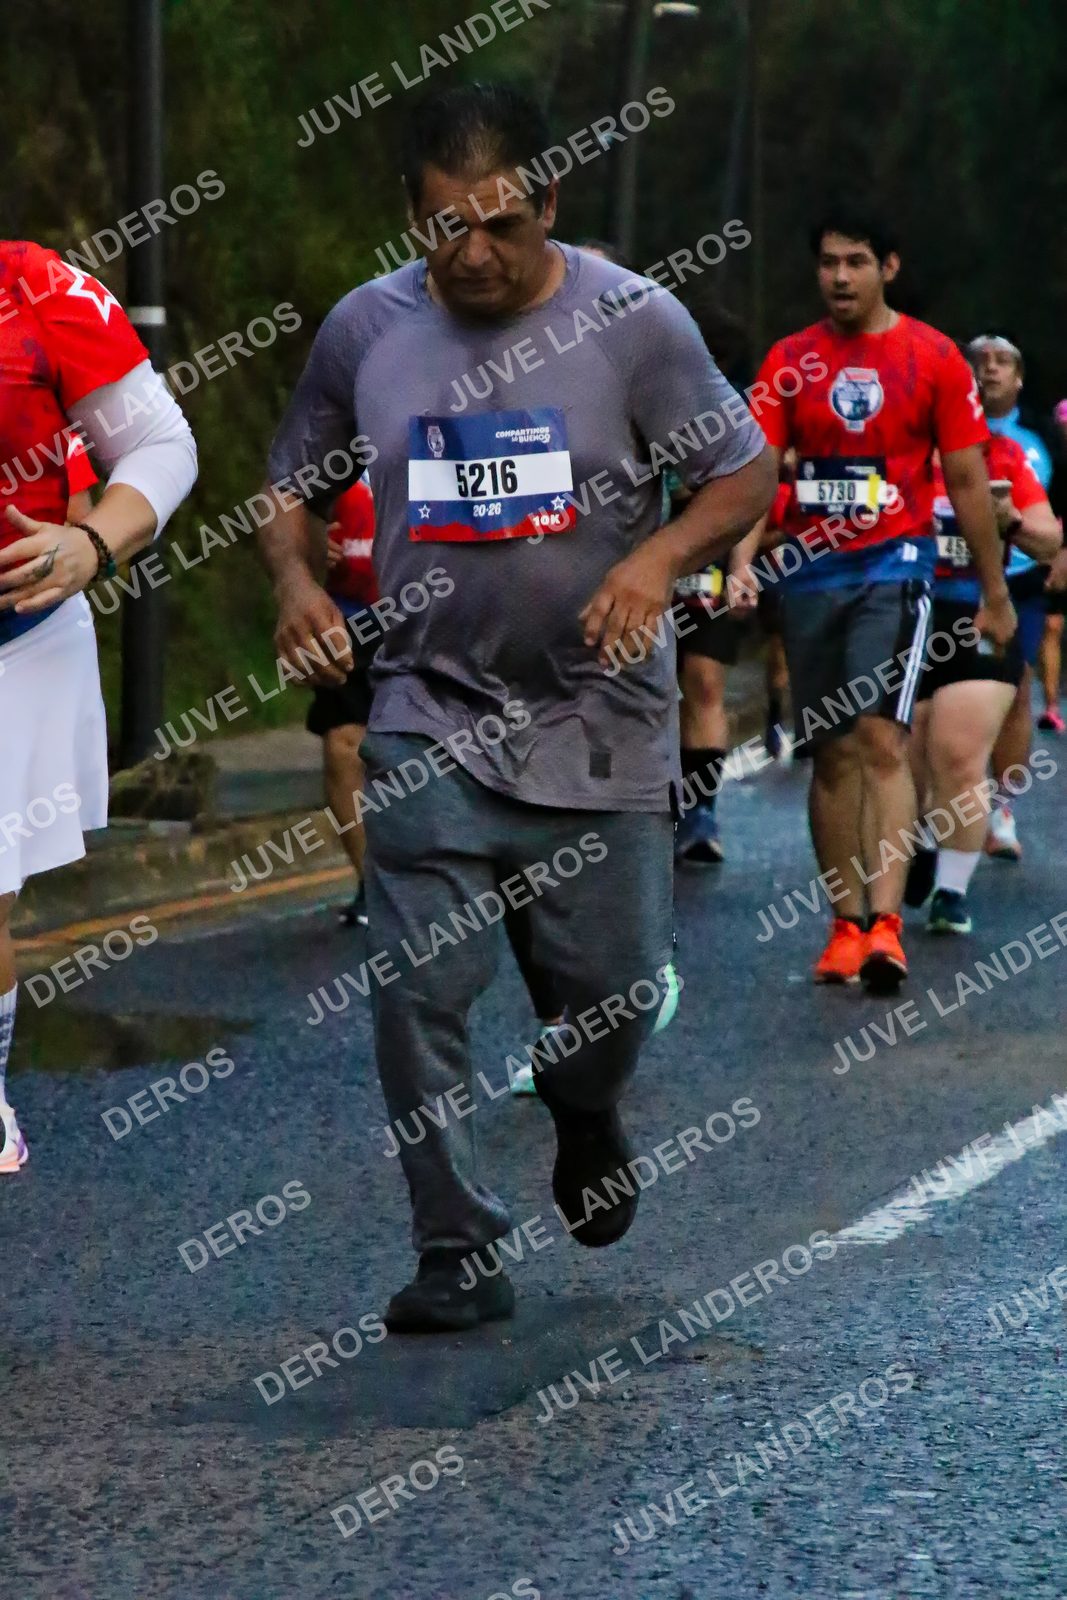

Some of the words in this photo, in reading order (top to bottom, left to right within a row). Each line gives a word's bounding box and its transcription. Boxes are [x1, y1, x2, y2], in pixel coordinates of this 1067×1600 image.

[455, 460, 518, 497] 5216
[818, 481, 856, 501] 5730
[532, 513, 561, 526] 10K
